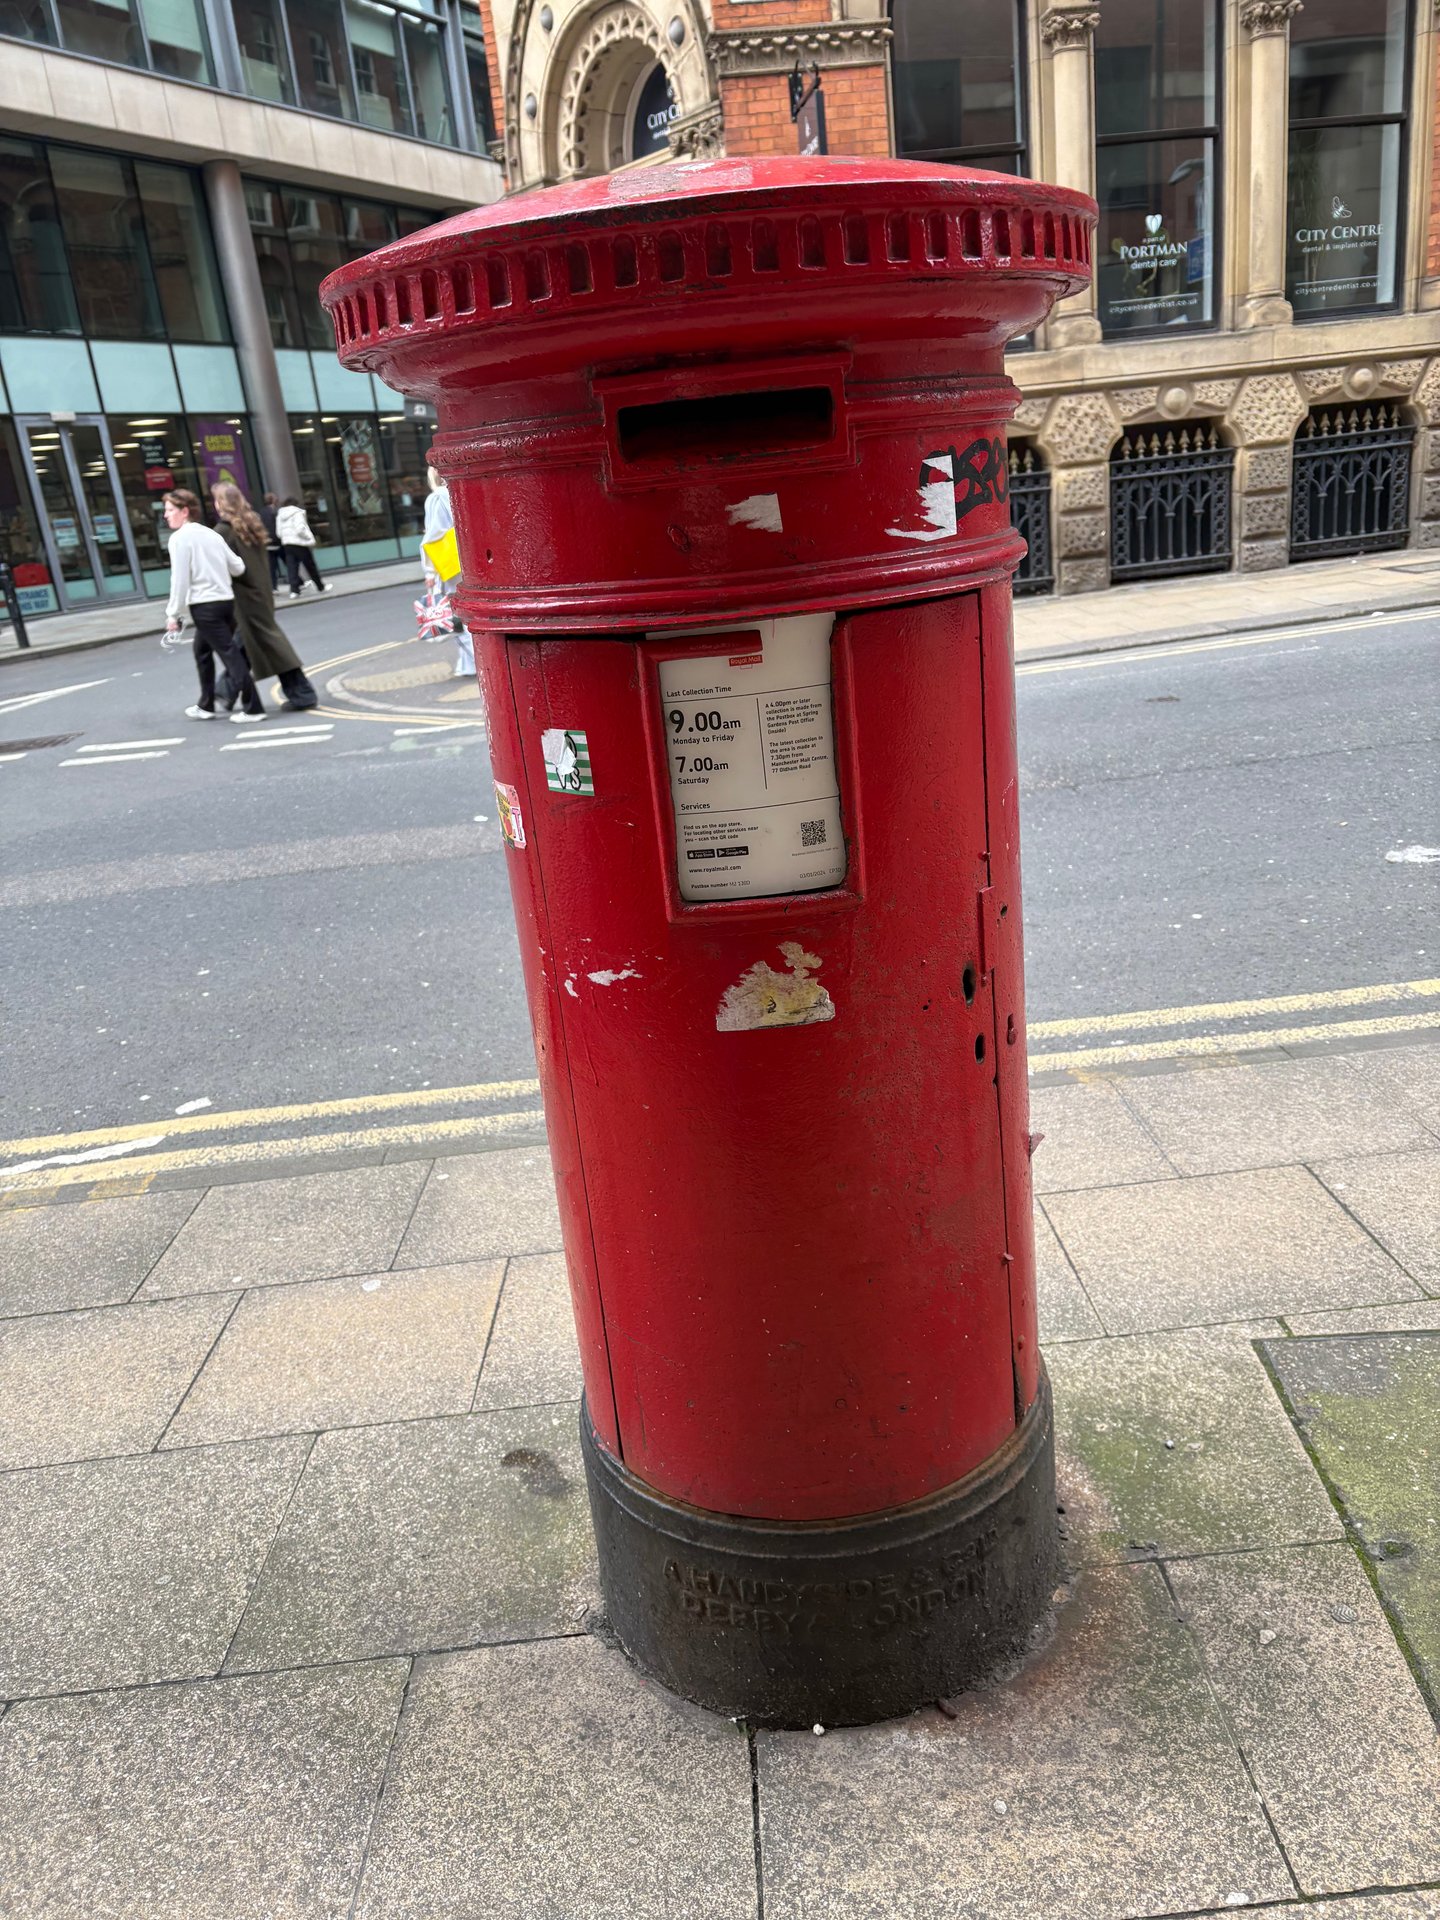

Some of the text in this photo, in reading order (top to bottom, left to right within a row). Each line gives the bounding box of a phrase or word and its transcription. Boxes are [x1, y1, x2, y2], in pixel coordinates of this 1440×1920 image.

[1296, 224, 1384, 242] CITY CENTRE
[1120, 241, 1188, 259] PORTMAN
[1302, 245, 1324, 253] dental
[1332, 242, 1358, 251] implant
[1131, 258, 1178, 270] dental care
[682, 688, 714, 696] Collection
[669, 710, 741, 733] 9.00am
[675, 756, 728, 773] 7.00am
[689, 865, 741, 873] www.royalmail.com
